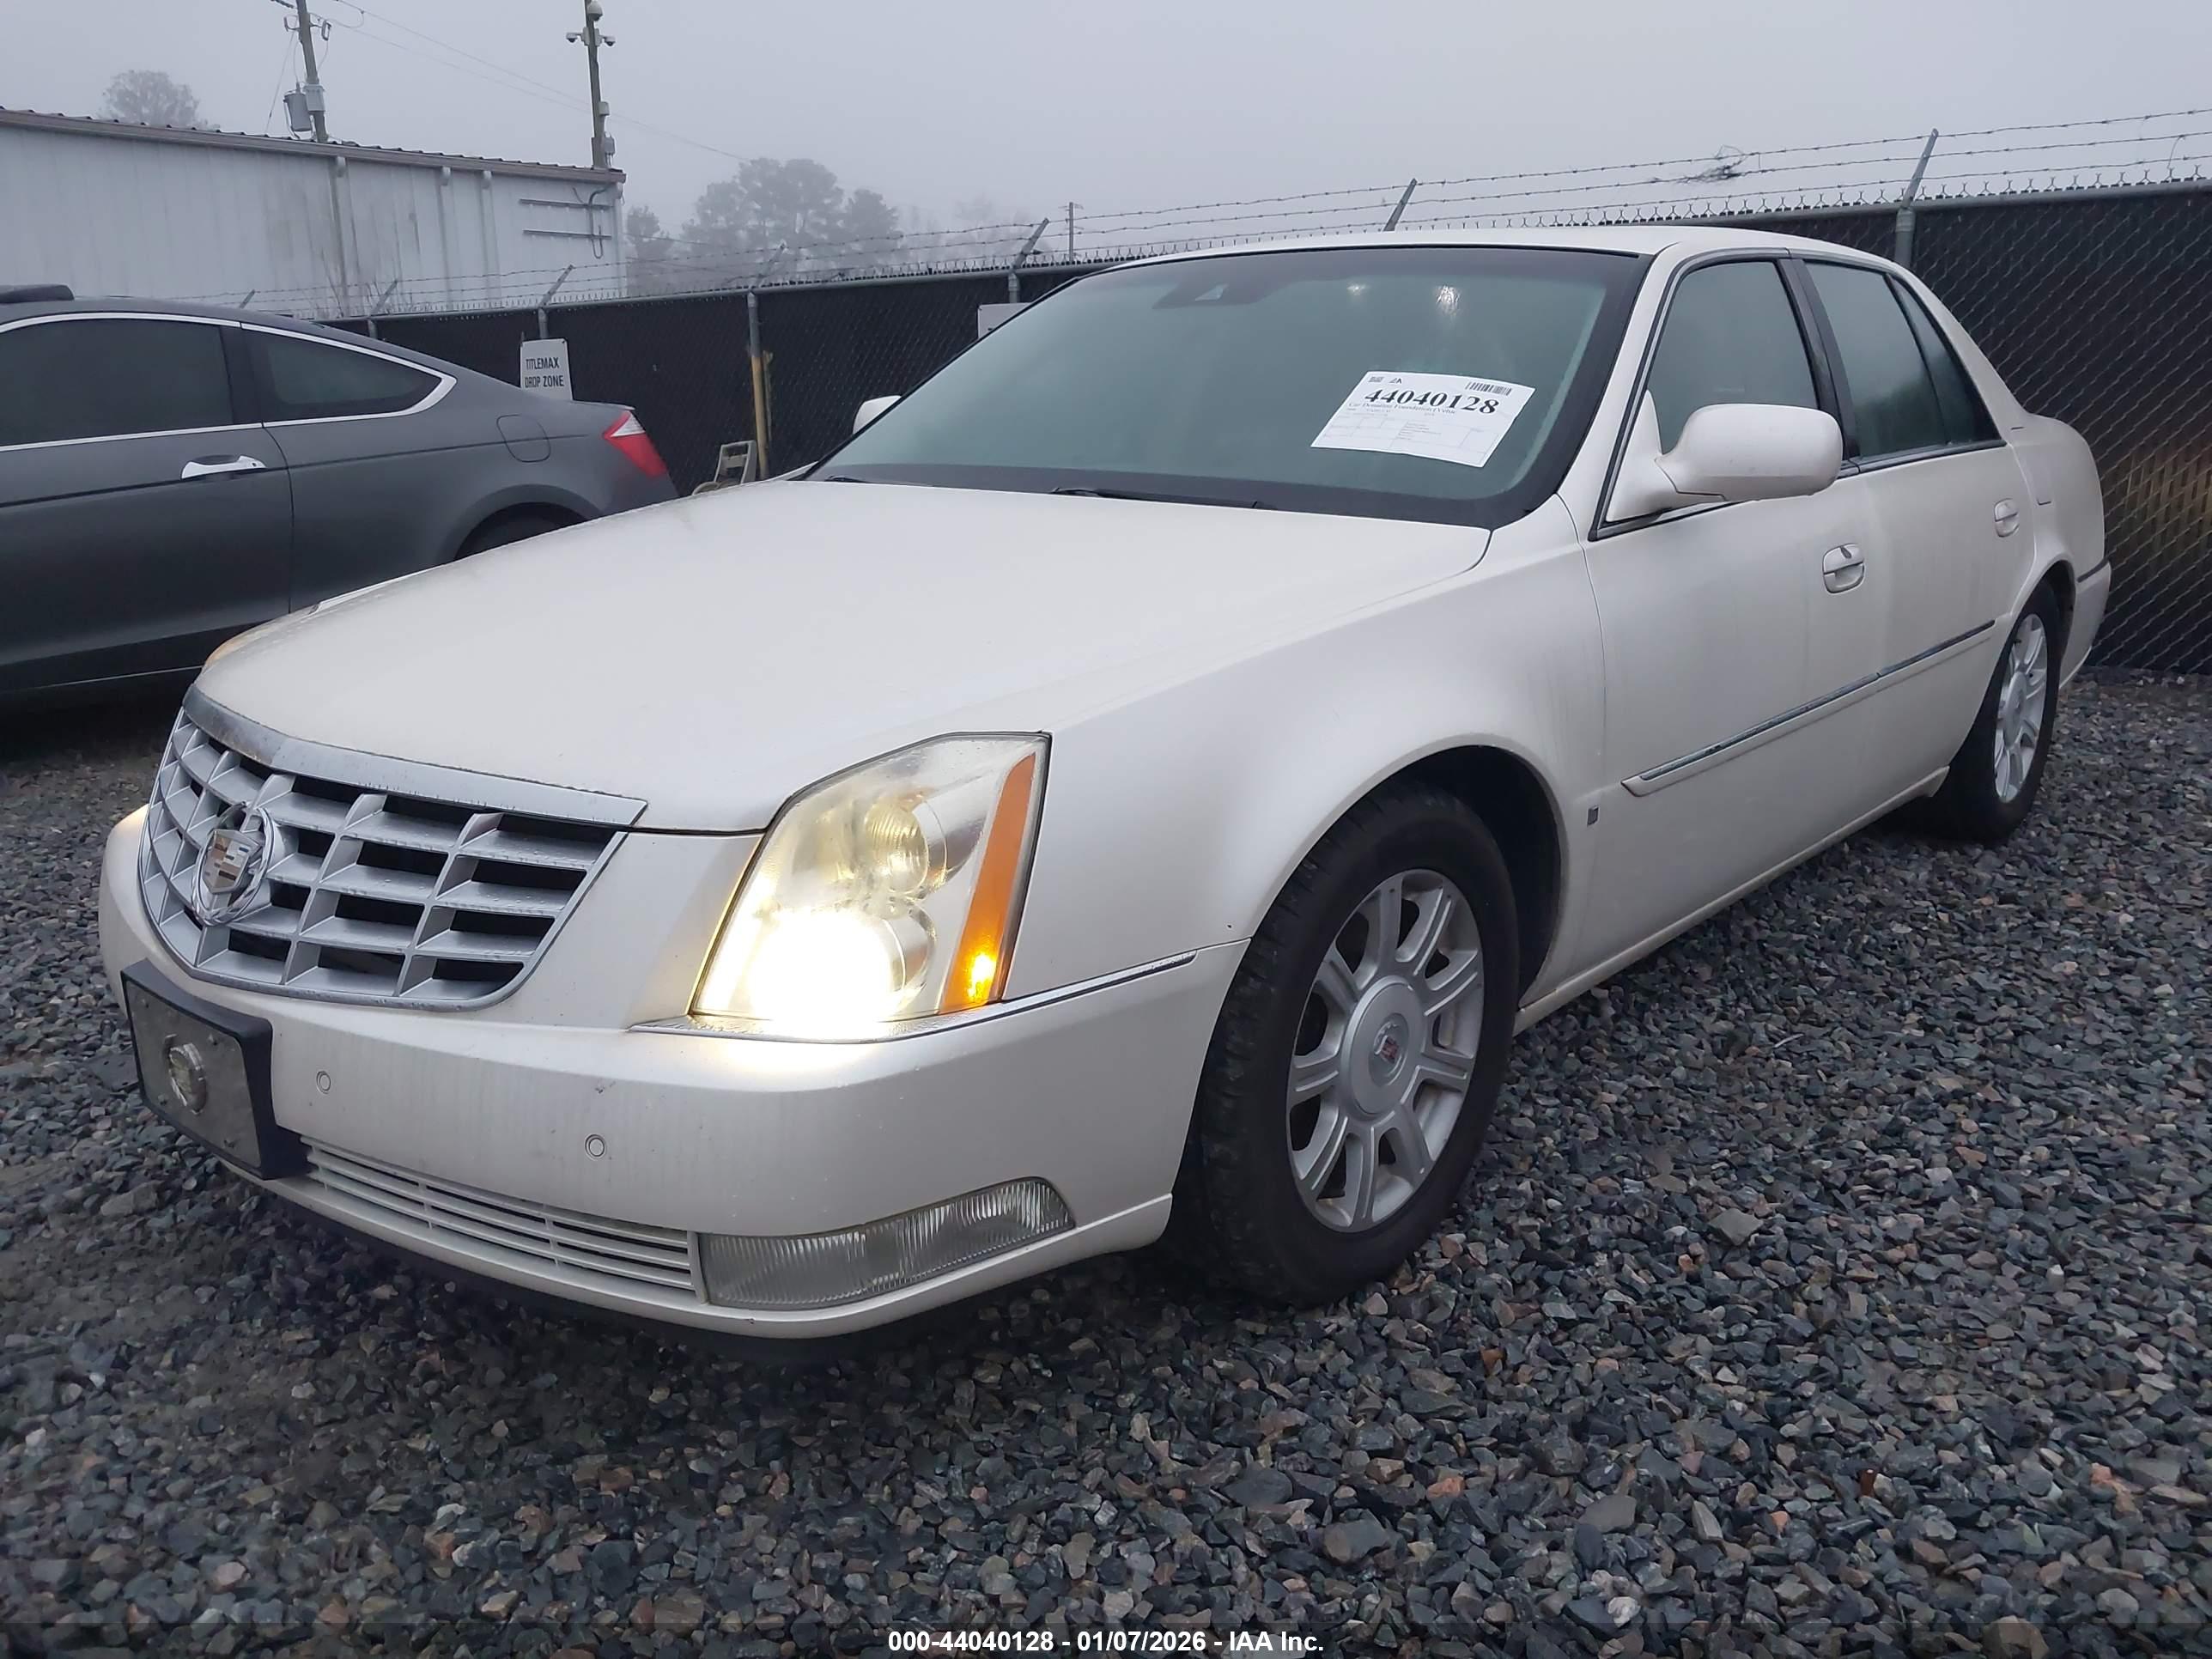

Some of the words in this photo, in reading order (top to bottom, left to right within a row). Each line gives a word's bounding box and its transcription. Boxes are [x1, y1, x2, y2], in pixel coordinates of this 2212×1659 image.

[526, 357, 559, 369] TITLEMAX
[525, 375, 540, 387] DROP
[543, 374, 564, 386] ZONE
[1364, 389, 1499, 414] 44040128
